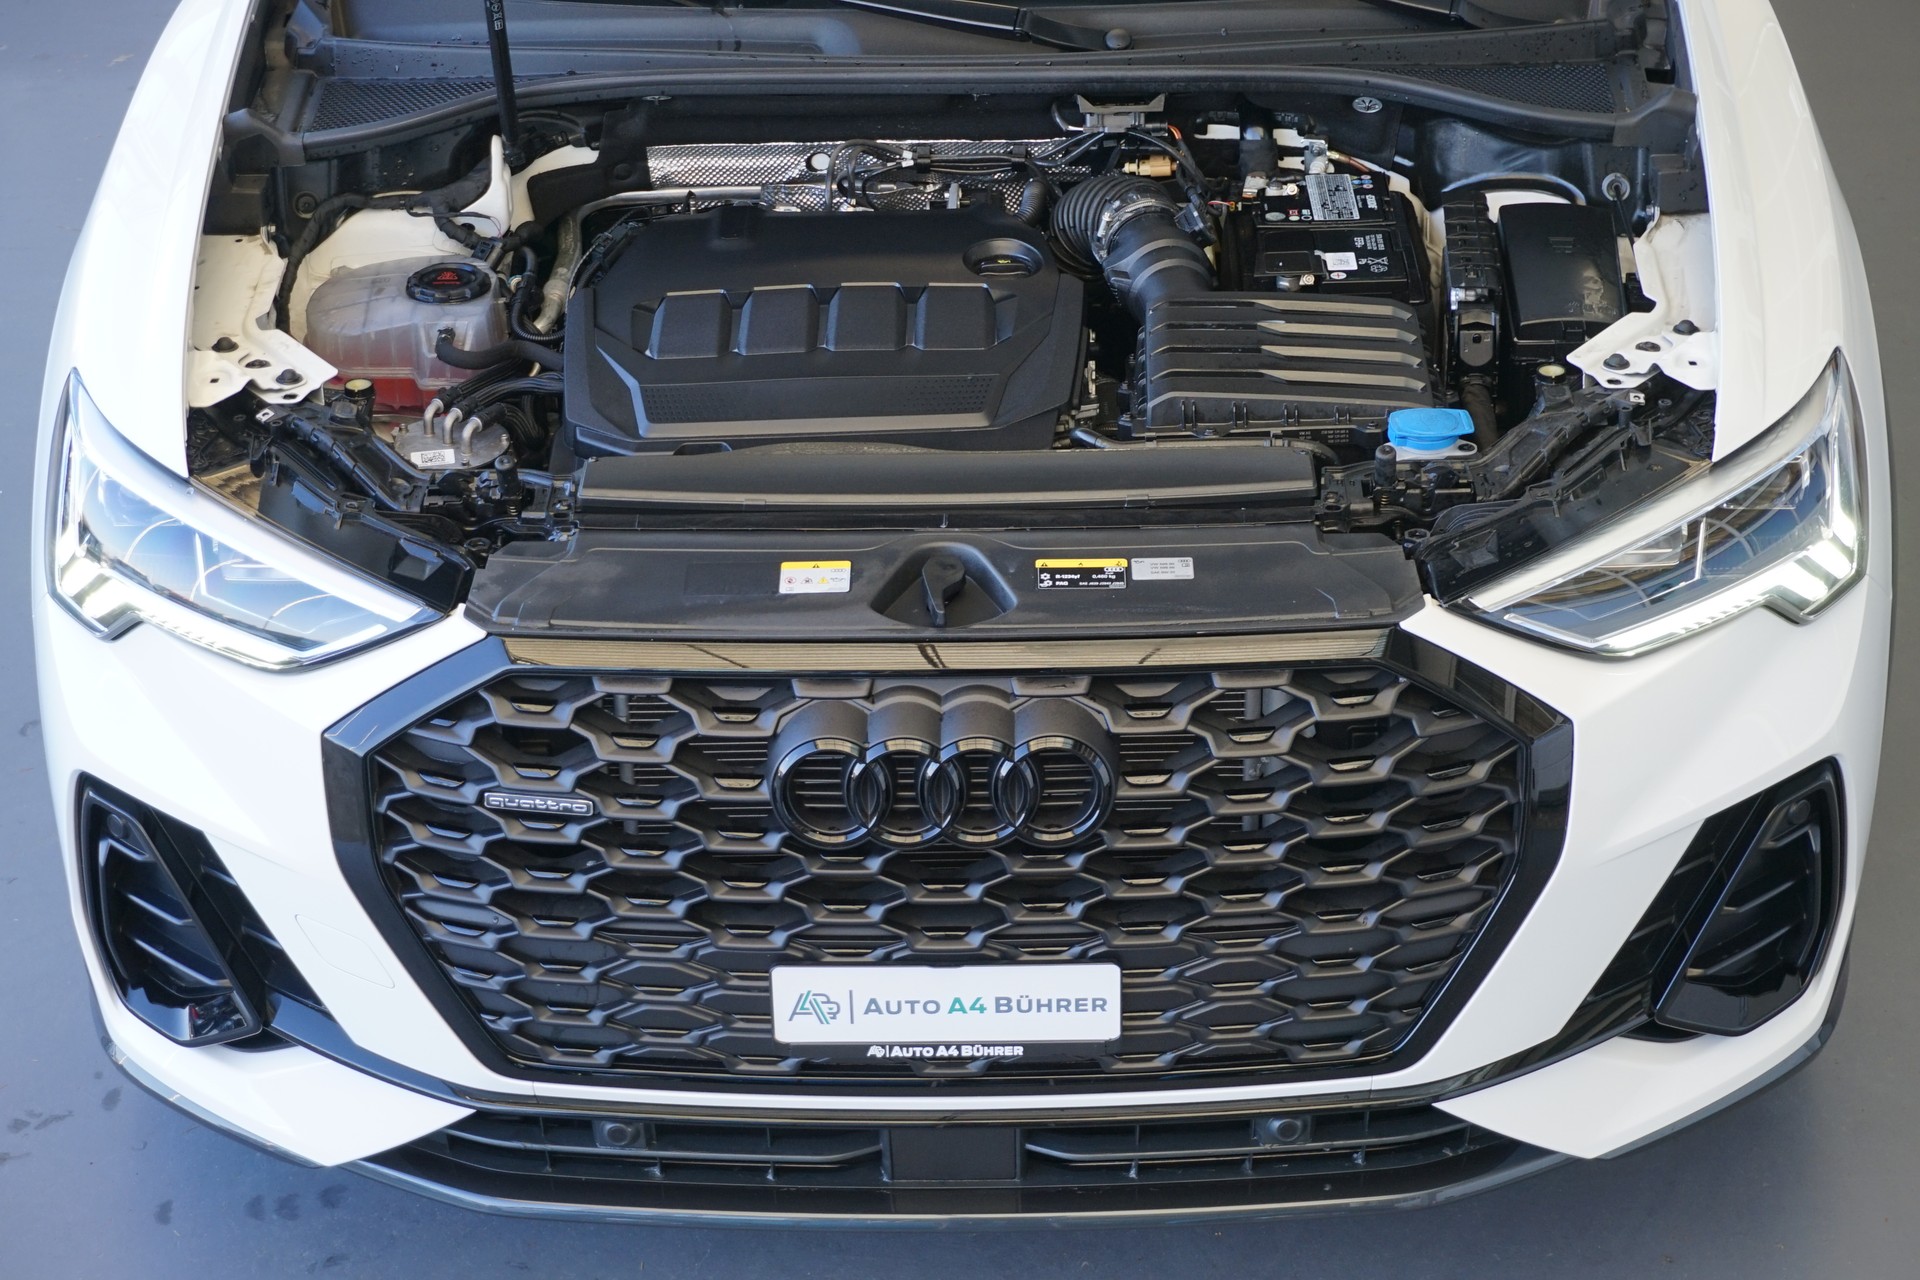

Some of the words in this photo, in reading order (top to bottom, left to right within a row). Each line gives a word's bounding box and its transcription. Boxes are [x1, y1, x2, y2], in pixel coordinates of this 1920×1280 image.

[488, 797, 588, 812] quattro
[863, 997, 941, 1015] AUTO
[947, 996, 987, 1014] A4
[994, 995, 1108, 1014] BÜHRER
[890, 1046, 935, 1057] AUTO
[936, 1045, 959, 1057] A4
[961, 1045, 1024, 1056] BÜHRER
